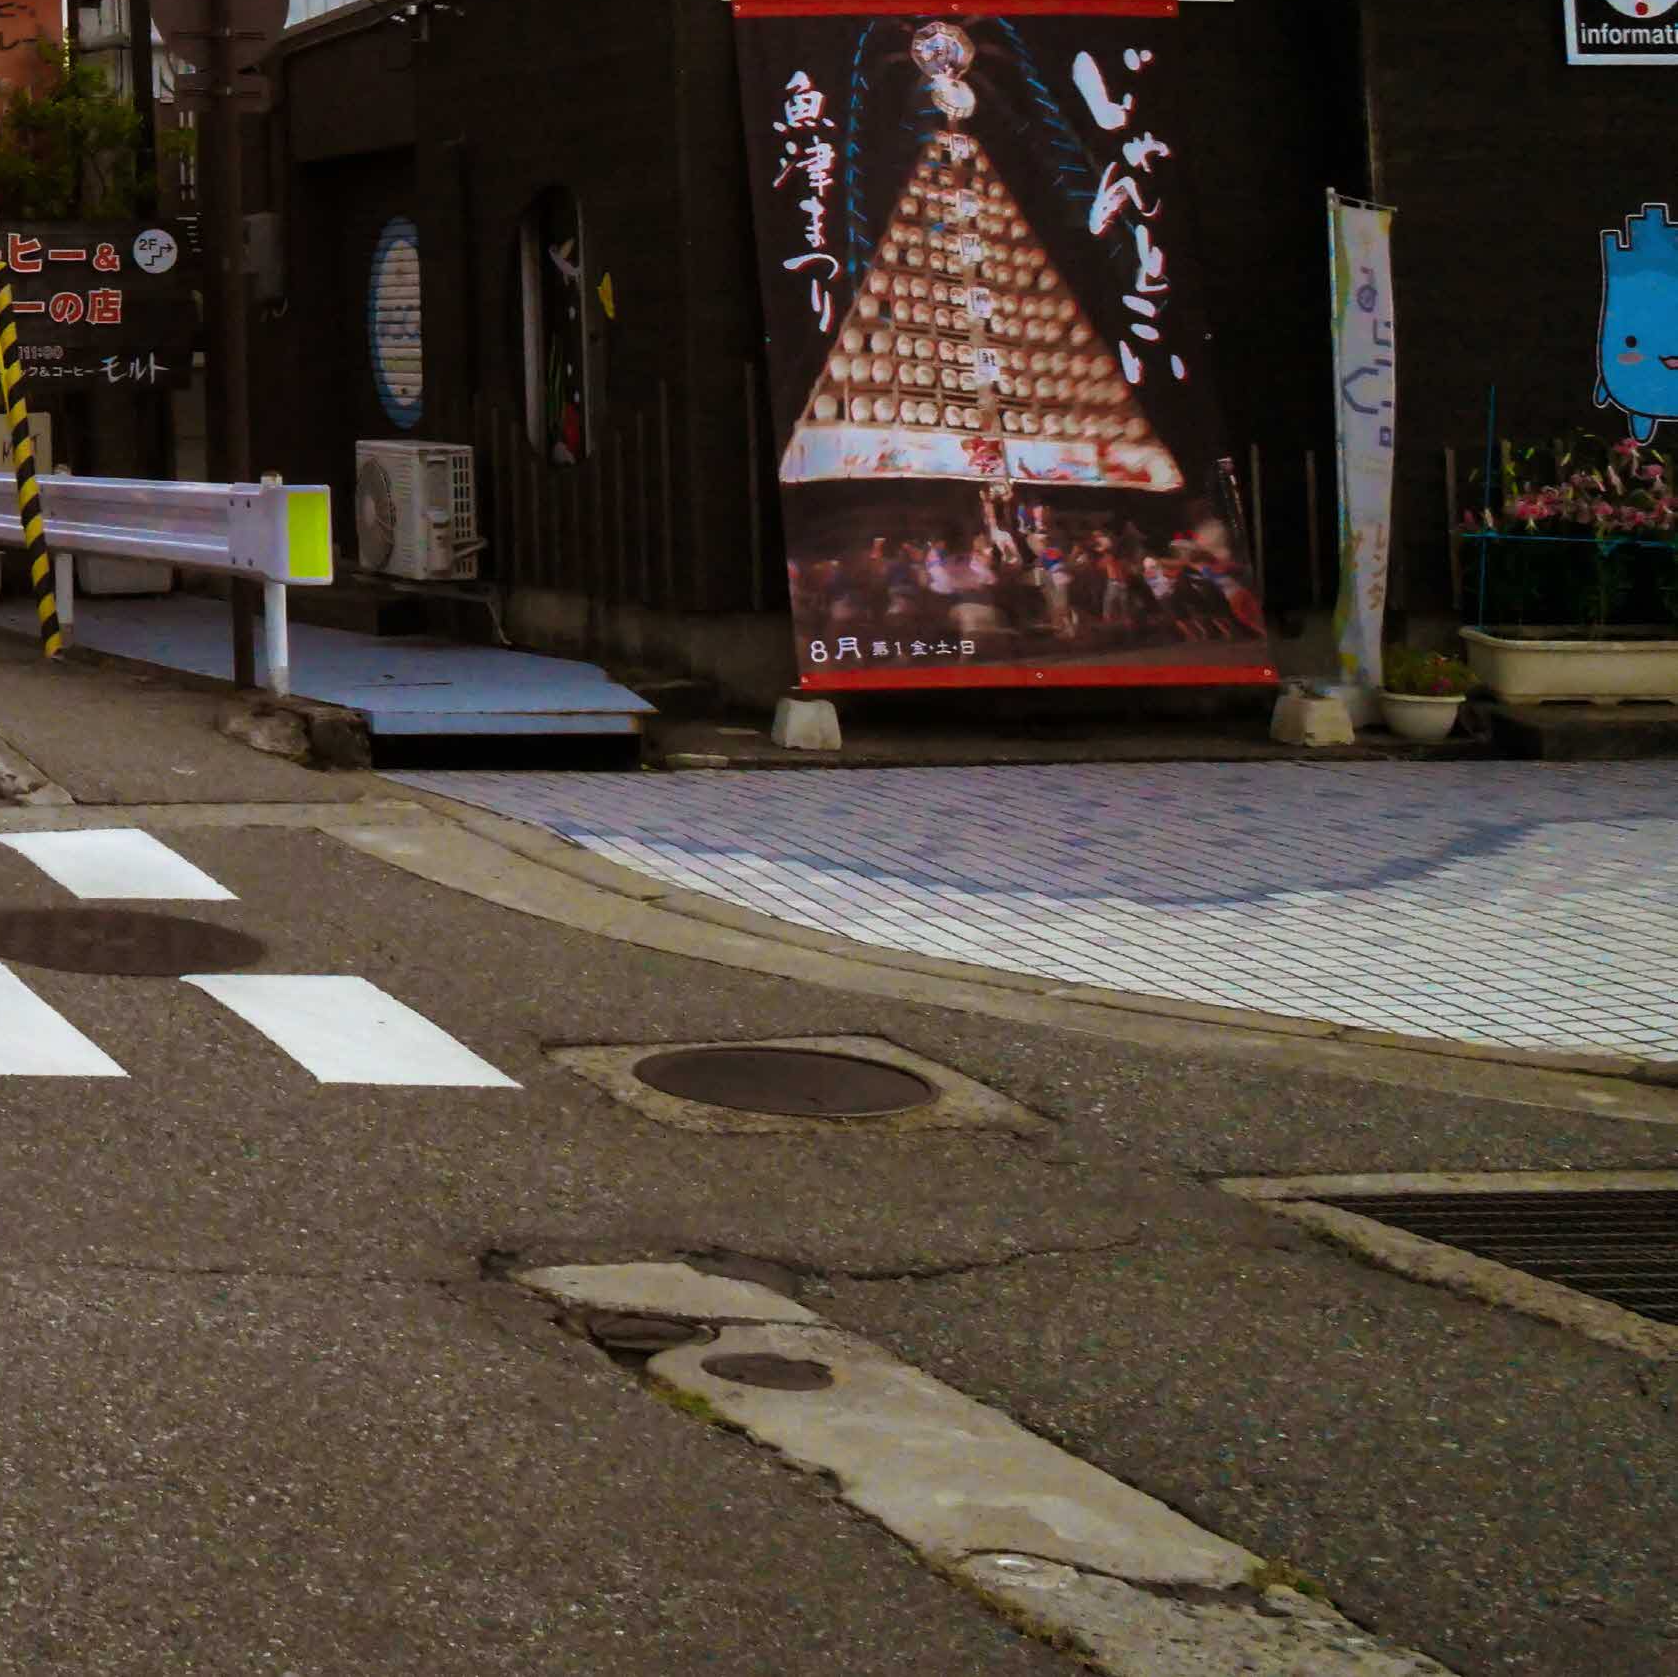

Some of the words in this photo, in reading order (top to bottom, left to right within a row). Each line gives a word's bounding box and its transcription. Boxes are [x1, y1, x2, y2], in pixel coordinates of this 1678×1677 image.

[773, 70, 839, 334] 魚津まつり
[139, 239, 156, 251] 2F
[100, 352, 170, 384] モルト
[810, 636, 862, 662] 8月
